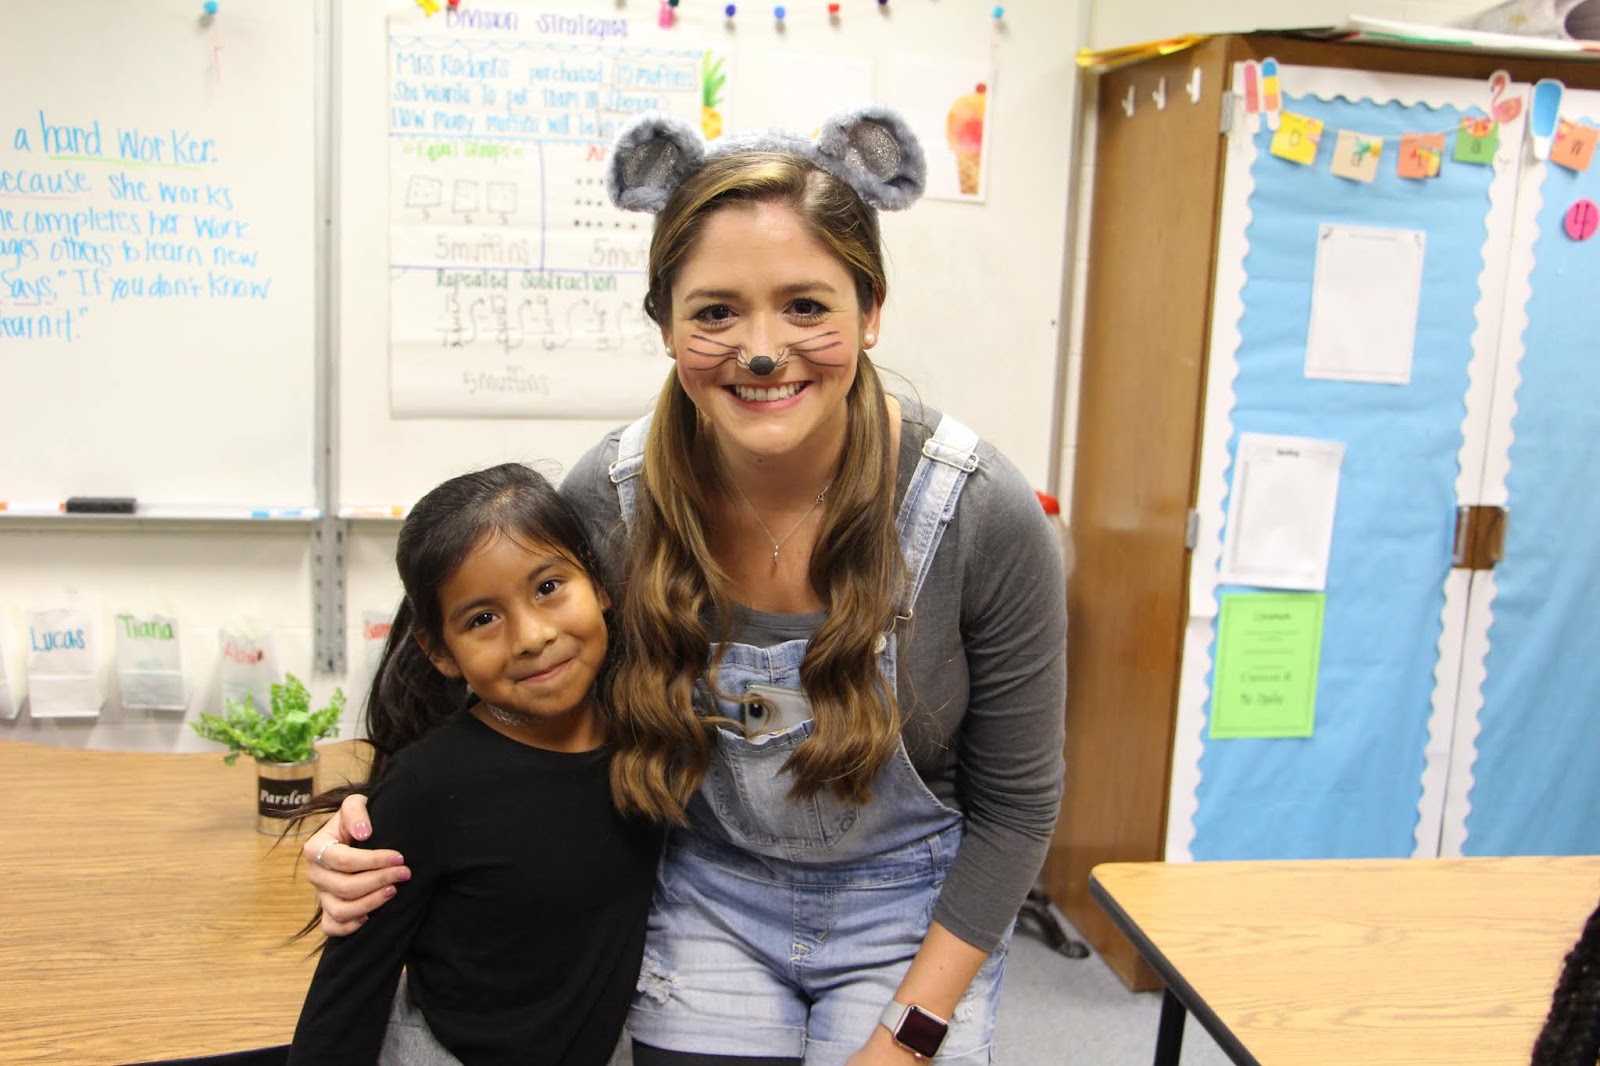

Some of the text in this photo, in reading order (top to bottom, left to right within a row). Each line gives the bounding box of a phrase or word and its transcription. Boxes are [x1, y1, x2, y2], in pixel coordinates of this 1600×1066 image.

[14, 127, 31, 152] a
[39, 109, 103, 158] hard
[0, 167, 92, 194] ecause
[23, 206, 142, 238] completes
[145, 238, 203, 267] learn
[213, 244, 259, 268] new
[110, 275, 144, 304] you
[436, 268, 618, 293] Repeated Subtraction
[29, 624, 87, 654] Lucas
[117, 613, 175, 643] Tiana
